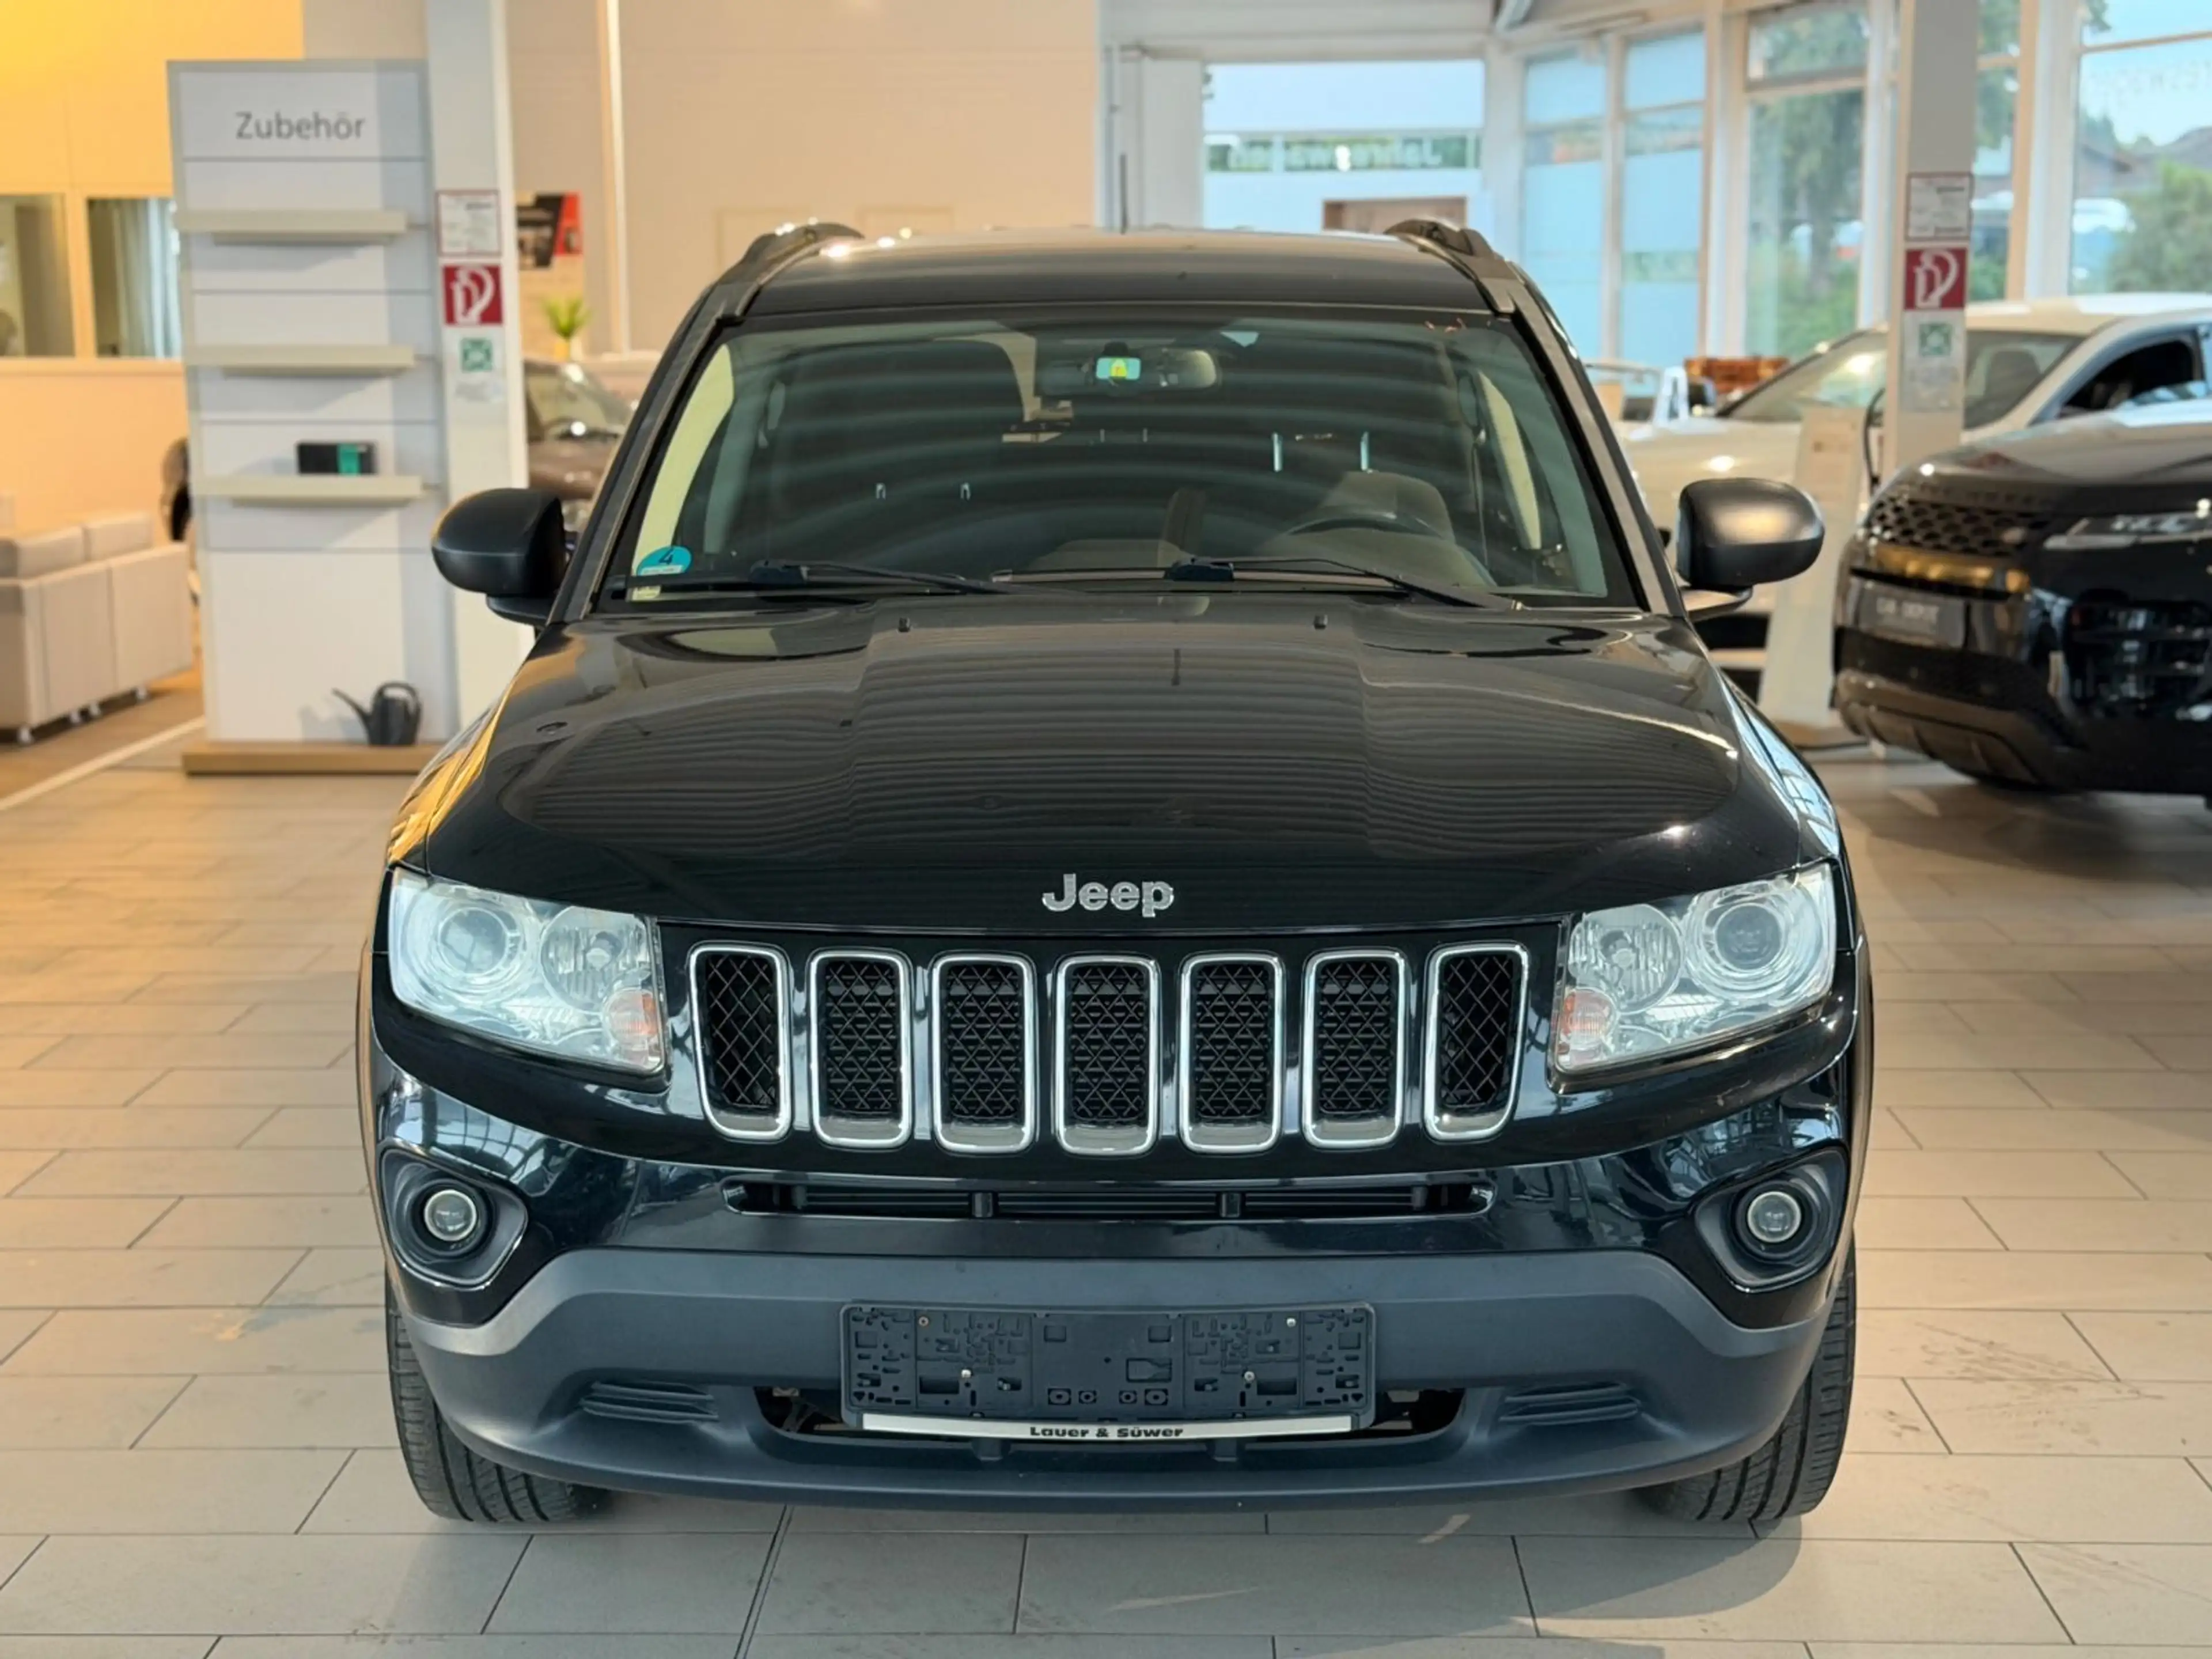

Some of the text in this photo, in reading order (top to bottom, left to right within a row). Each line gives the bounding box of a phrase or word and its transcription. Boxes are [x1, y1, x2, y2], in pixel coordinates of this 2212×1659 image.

[235, 110, 366, 140] Zubehör
[658, 546, 676, 565] 4
[1041, 873, 1175, 918] Jeep
[1029, 1426, 1184, 1438] Lauer & Süwer
